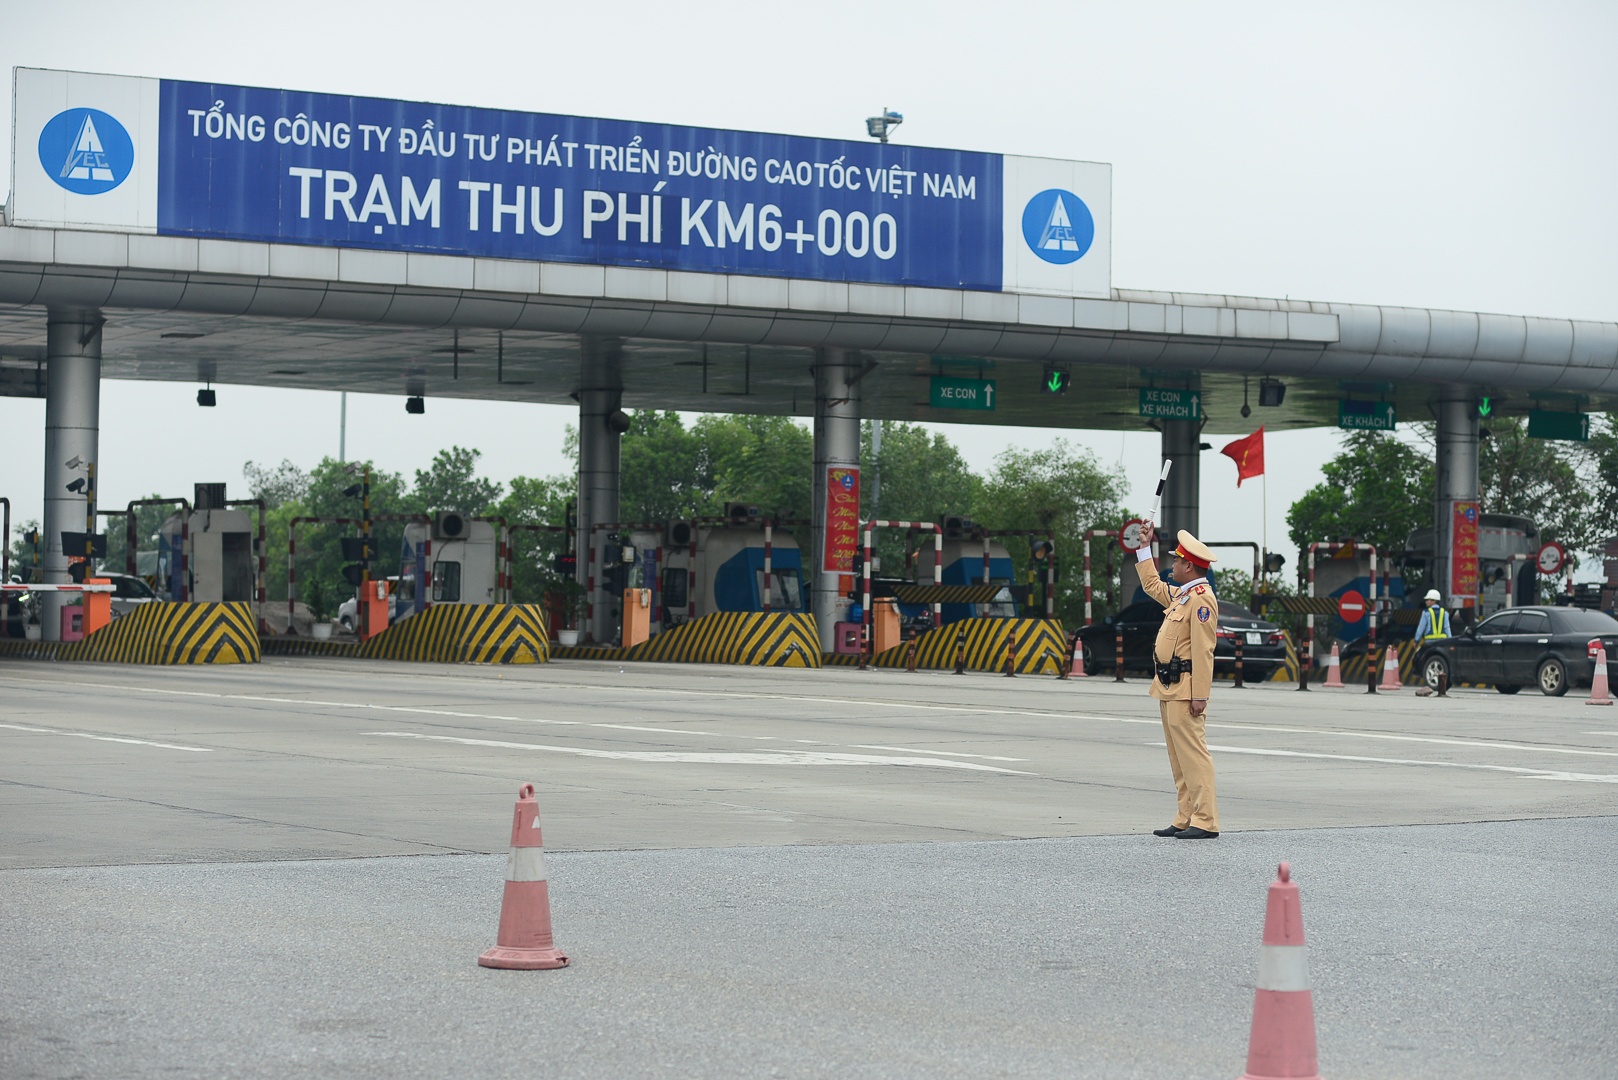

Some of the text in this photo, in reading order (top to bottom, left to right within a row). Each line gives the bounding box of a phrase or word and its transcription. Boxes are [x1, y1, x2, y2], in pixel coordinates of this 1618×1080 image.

[187, 99, 266, 143] TỔNG
[273, 112, 351, 150] CÔNG
[357, 124, 392, 153] TY
[398, 118, 457, 159] ĐẦU
[464, 133, 500, 162] TƯ
[507, 134, 579, 168] PHÁT
[584, 135, 660, 175] TRIỂN
[667, 145, 758, 182] ĐƯỜNG
[865, 164, 917, 200] VIỆT
[923, 172, 977, 200] NAM
[288, 166, 898, 260] TRẠM THU PHÍ KM6+000
[941, 386, 977, 399] XE CON
[1146, 390, 1181, 403] XE CON
[1142, 402, 1189, 417] XE KHÁCH
[1341, 413, 1387, 428] XE KHÁCH
